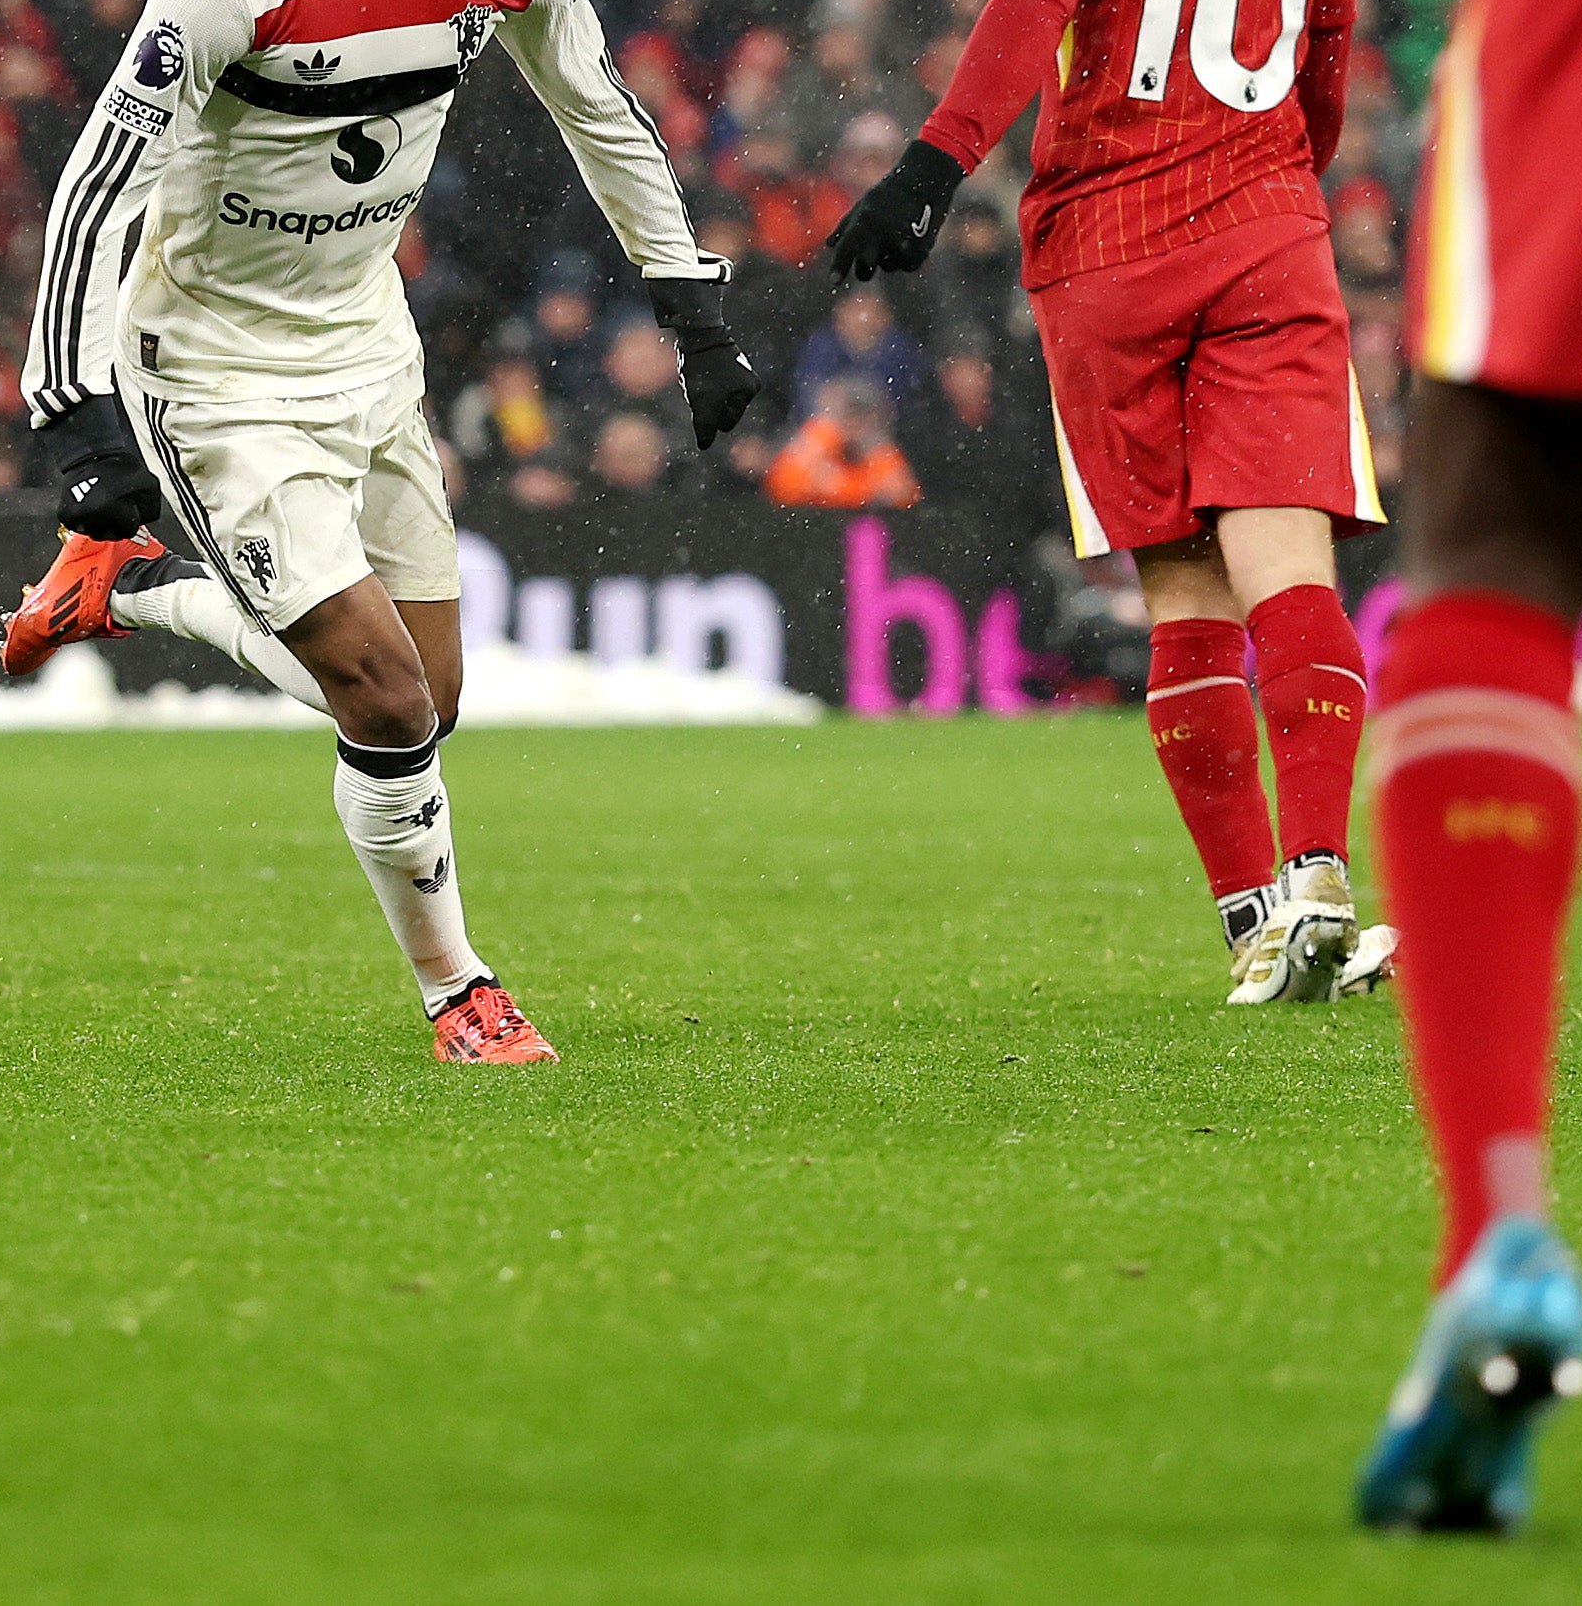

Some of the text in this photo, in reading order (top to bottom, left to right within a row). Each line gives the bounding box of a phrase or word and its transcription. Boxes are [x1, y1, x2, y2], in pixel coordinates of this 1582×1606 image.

[105, 99, 121, 115] or
[124, 96, 165, 123] room
[1306, 697, 1352, 722] LFC
